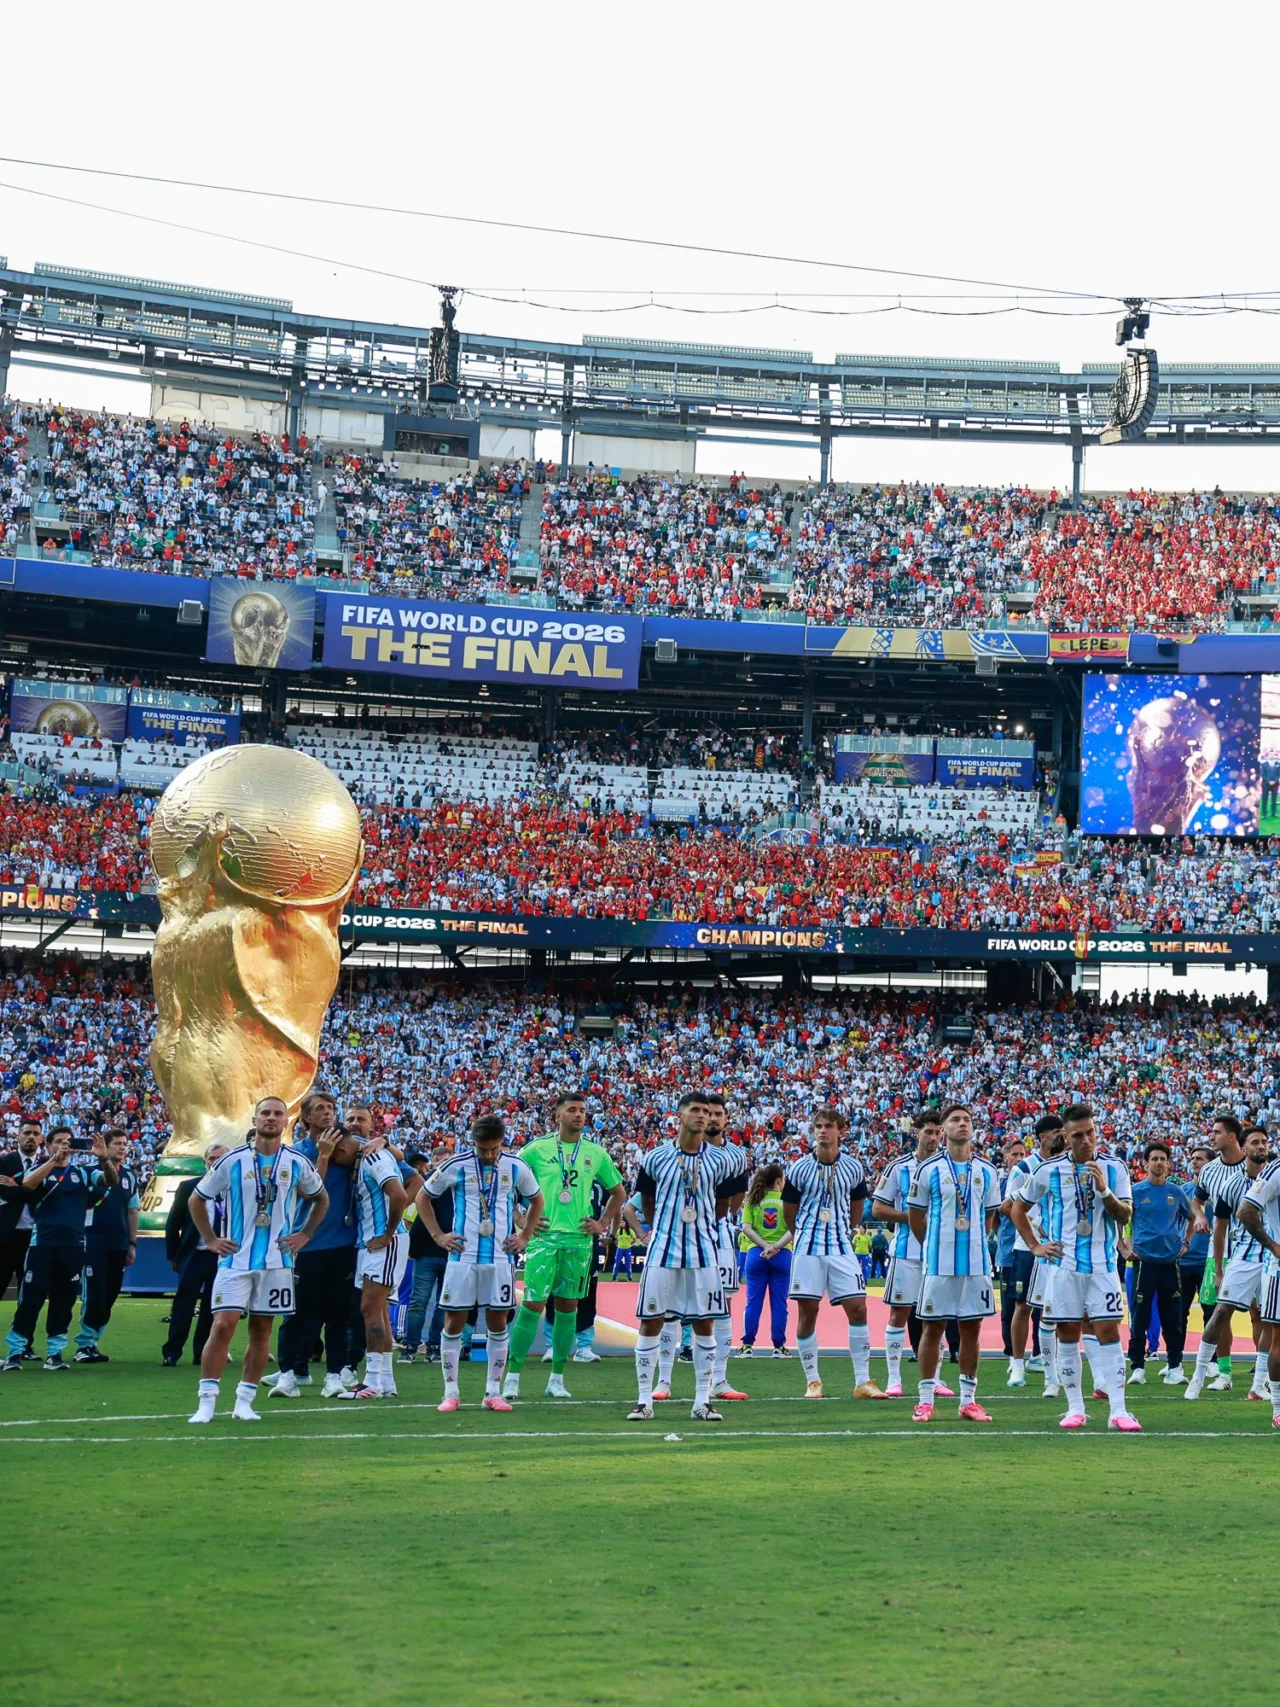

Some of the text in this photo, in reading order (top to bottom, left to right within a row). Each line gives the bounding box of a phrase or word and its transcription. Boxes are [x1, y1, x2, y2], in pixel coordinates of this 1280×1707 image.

[342, 604, 625, 643] FIFA WORLD CUP 2026
[342, 626, 623, 678] THE FINAL
[1070, 638, 1109, 652] LEPE
[142, 718, 225, 734] THE FINAL
[160, 713, 186, 721] WORLD
[201, 717, 226, 725] 2026
[948, 766, 1021, 776] THE FINAL
[353, 914, 383, 927] CUP
[384, 916, 435, 930] 2026
[441, 919, 475, 932] THE
[478, 922, 529, 935] FINAL
[697, 928, 826, 947] CHAMPIONS
[988, 938, 1016, 950] FIFA
[1018, 939, 1067, 951] WORLD
[1098, 941, 1146, 952] 2026
[1151, 941, 1182, 952] THE
[1185, 941, 1232, 953] FINAL
[269, 1288, 291, 1308] 20
[500, 1285, 510, 1303] 3
[708, 1290, 722, 1310] 14
[981, 1290, 989, 1308] 4
[1106, 1292, 1122, 1312] 22
